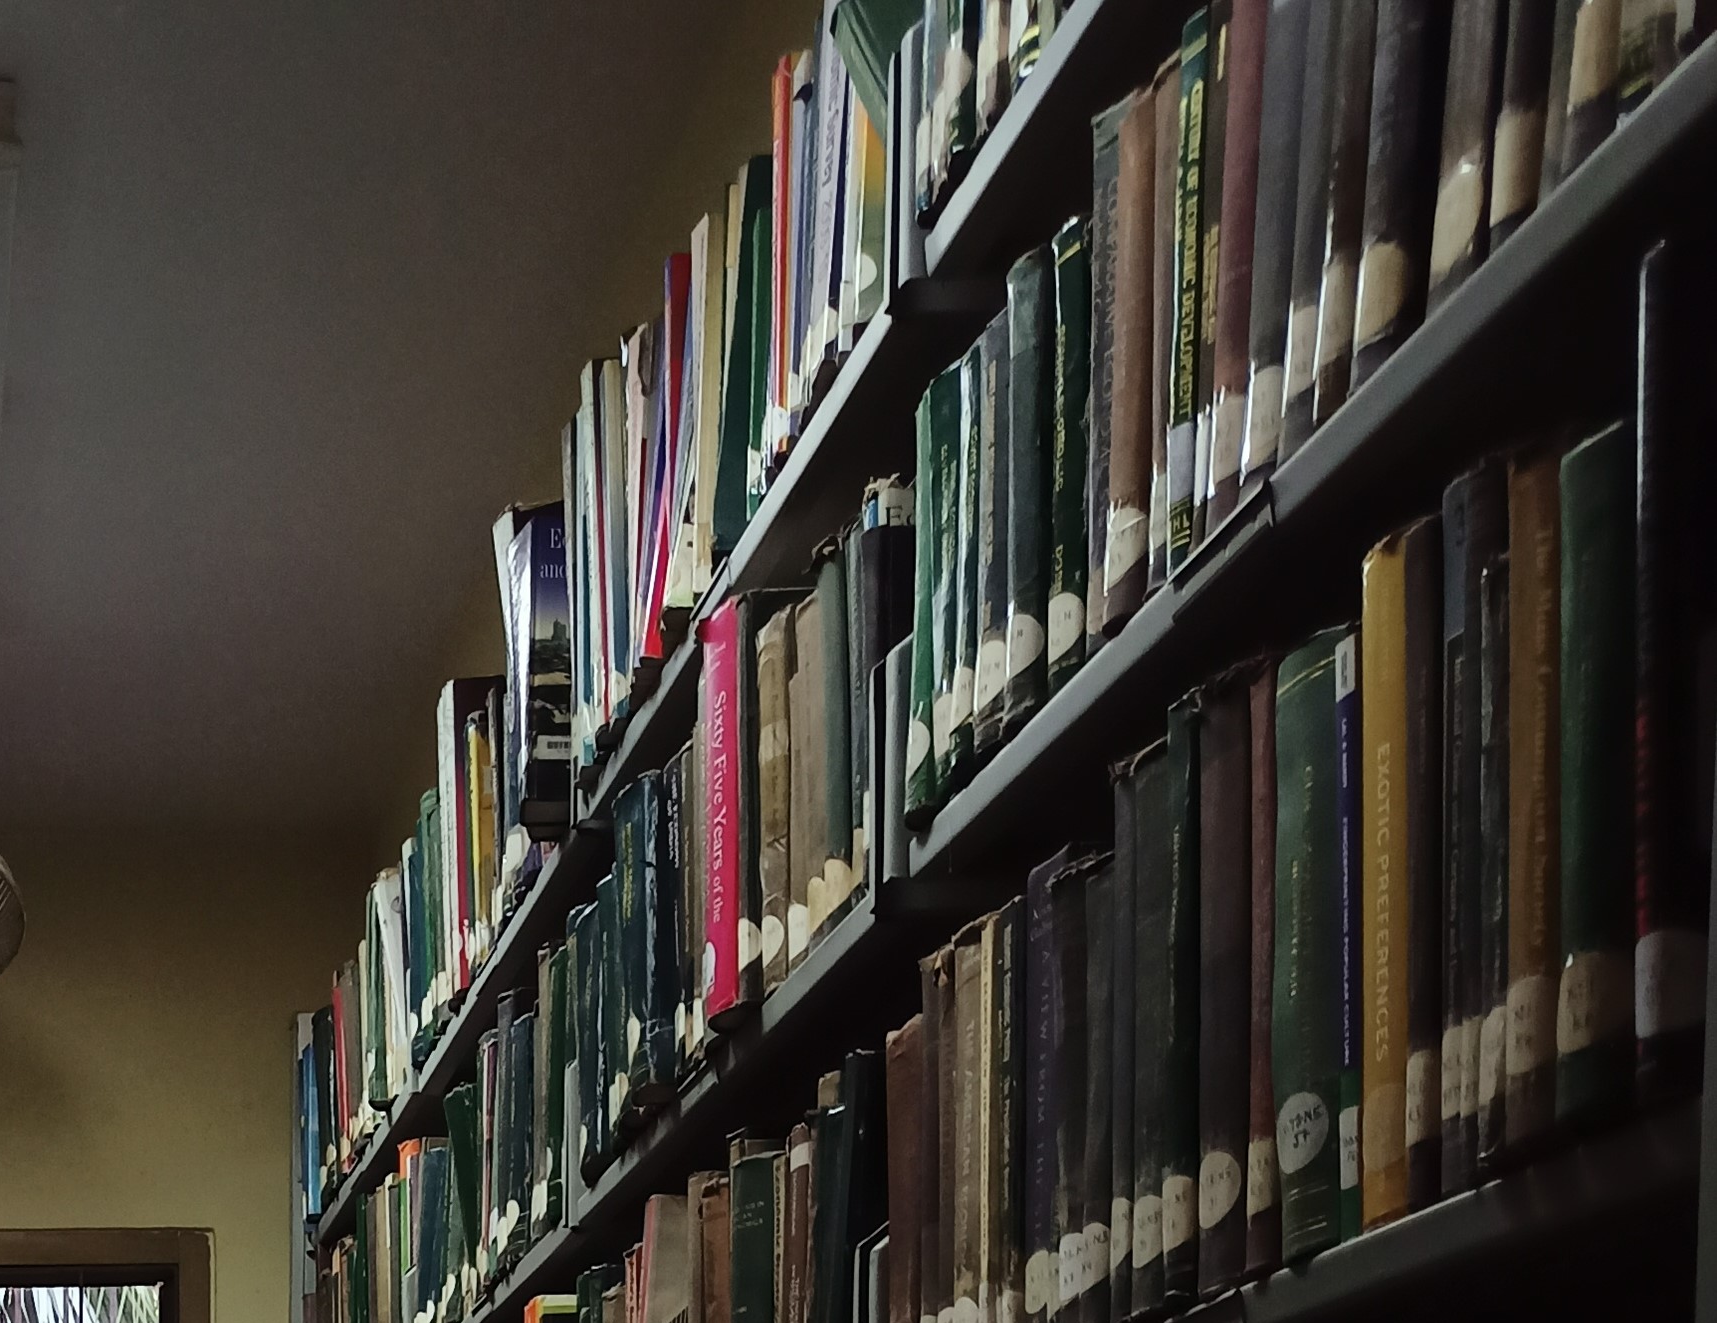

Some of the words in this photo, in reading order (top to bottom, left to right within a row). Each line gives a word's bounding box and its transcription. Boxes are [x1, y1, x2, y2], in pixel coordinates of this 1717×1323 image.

[1179, 291, 1197, 417] DEVELOPMENT
[711, 690, 727, 748] Sixty
[712, 755, 727, 804] Five
[1376, 742, 1390, 847] EXOTIC
[711, 811, 727, 870] Years
[712, 876, 723, 893] of
[712, 896, 724, 923] the
[1376, 855, 1389, 1062] PREFERENCES
